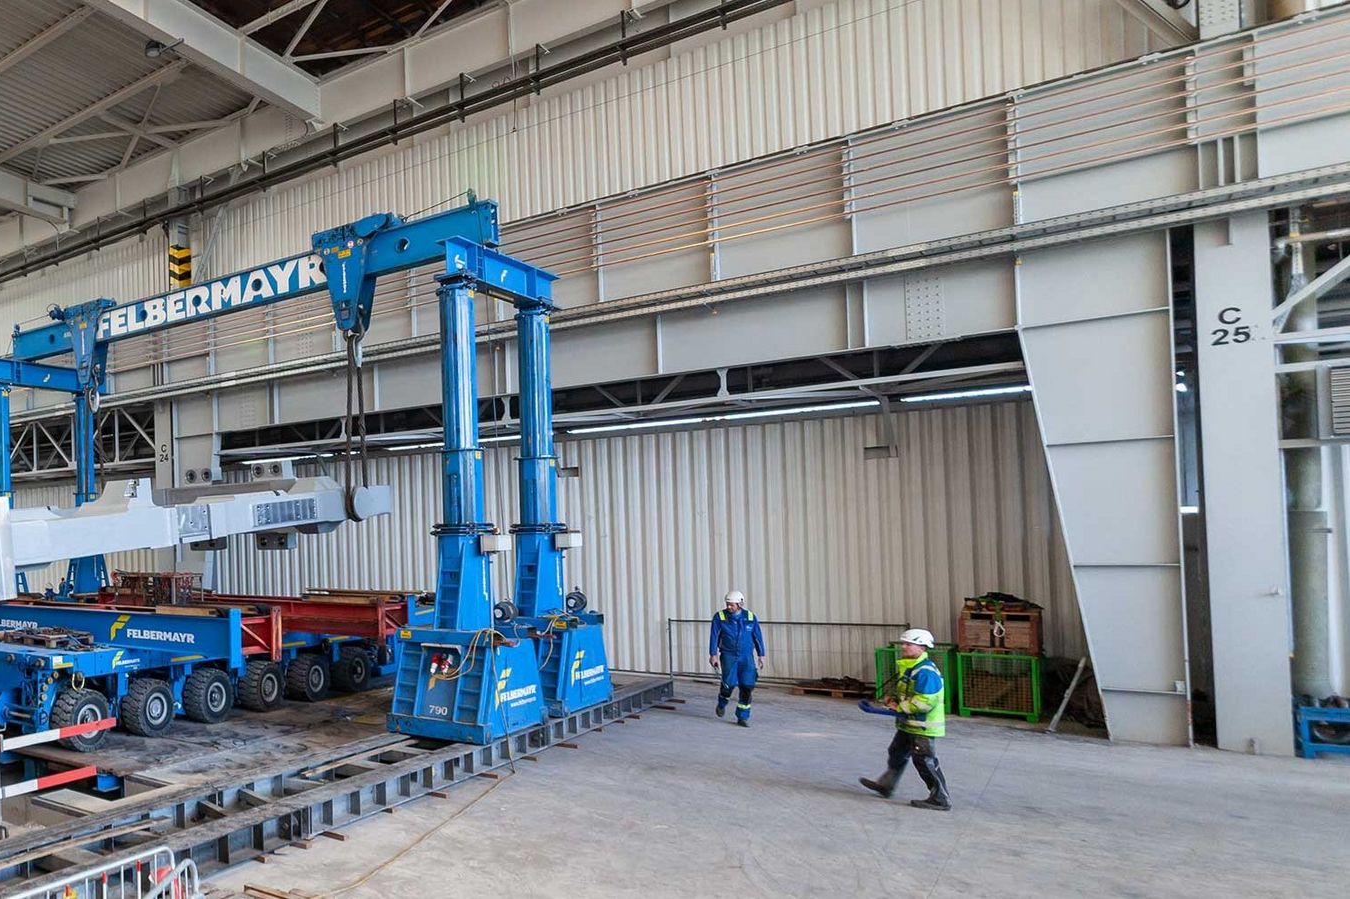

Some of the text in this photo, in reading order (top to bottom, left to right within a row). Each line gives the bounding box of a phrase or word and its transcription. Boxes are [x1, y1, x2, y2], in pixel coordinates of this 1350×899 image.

[97, 255, 328, 339] FELBERMAYR
[1218, 307, 1242, 325] C
[1211, 326, 1251, 346] 25
[160, 444, 167, 453] C
[159, 454, 169, 463] 24
[126, 629, 195, 644] FELBERMAYR
[428, 704, 448, 716] 790
